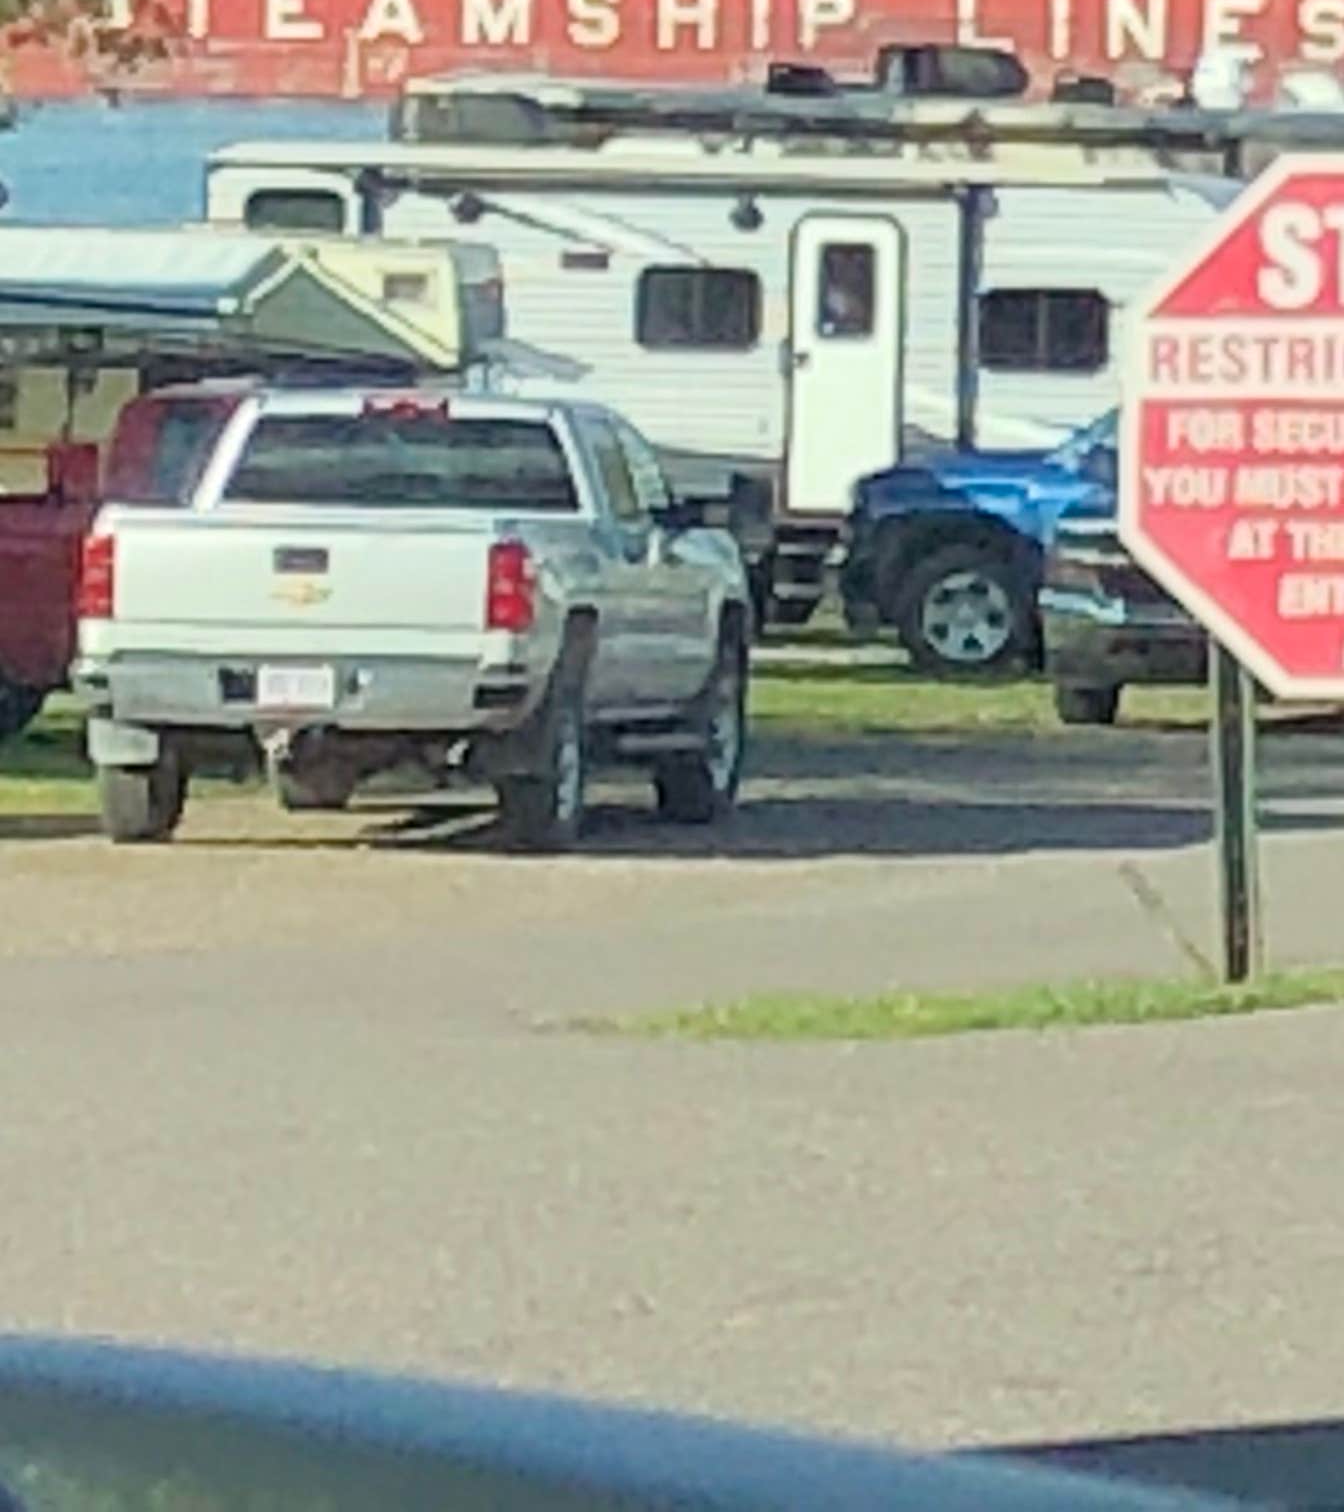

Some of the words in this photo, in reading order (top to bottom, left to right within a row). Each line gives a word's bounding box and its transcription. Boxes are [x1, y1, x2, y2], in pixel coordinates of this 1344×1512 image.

[1167, 409, 1243, 453] FOR
[1145, 465, 1228, 507] YOU
[1234, 465, 1344, 508] MUST
[1228, 519, 1279, 560] AT
